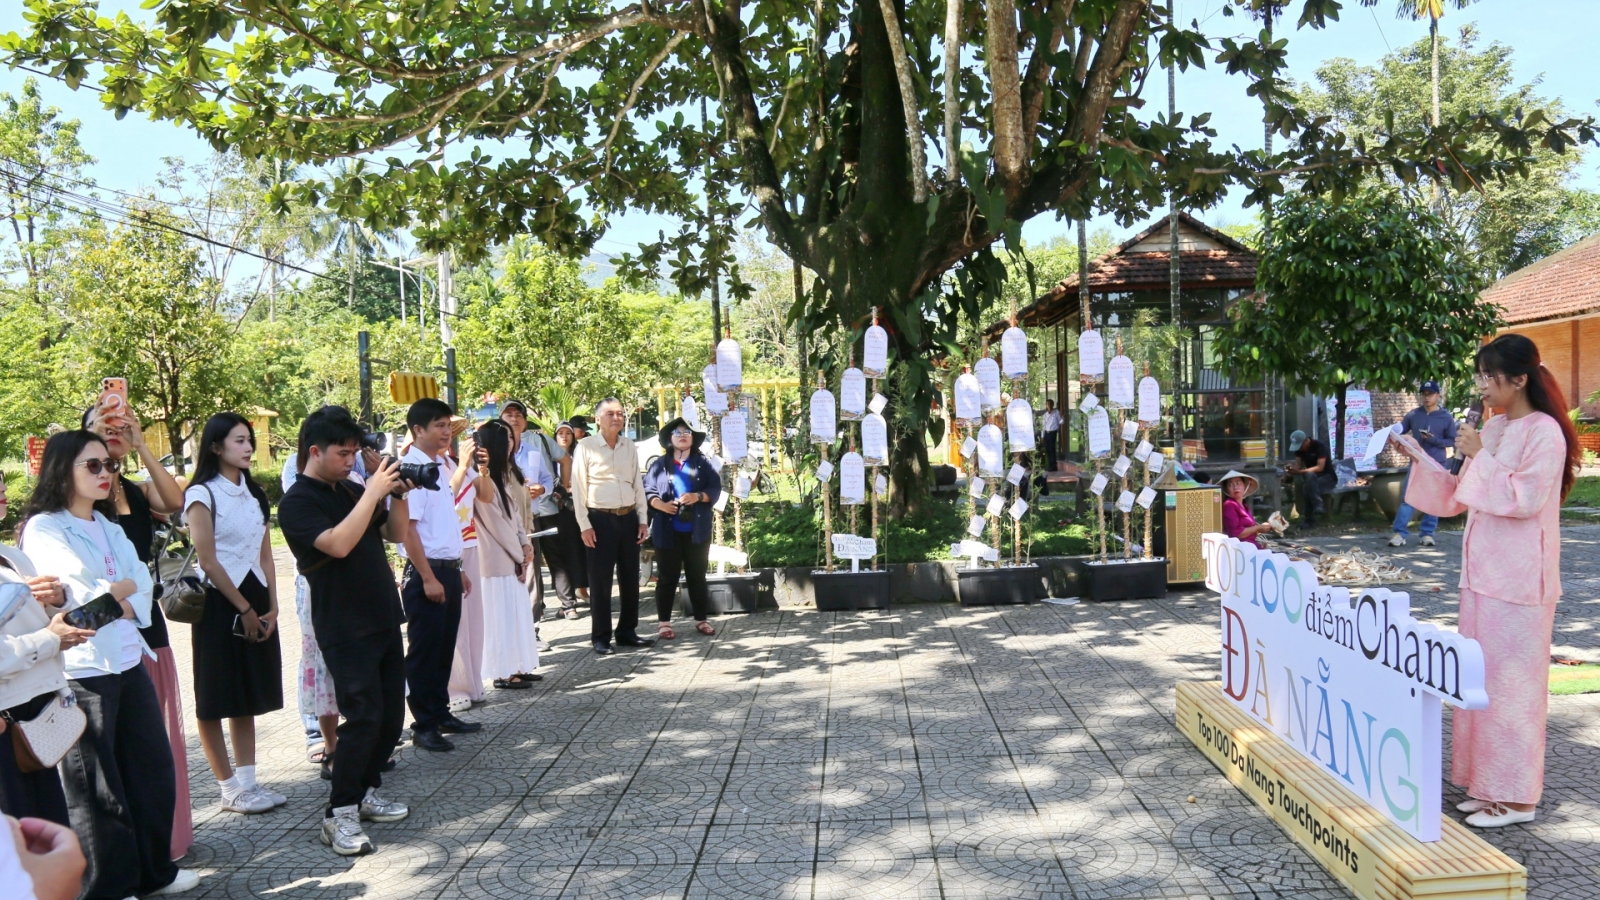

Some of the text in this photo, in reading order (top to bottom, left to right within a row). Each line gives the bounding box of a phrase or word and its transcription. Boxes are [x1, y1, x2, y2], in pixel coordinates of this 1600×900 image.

[1203, 538, 1464, 701] TOP 100 điểm Chạm
[1197, 712, 1359, 874] Top 100 Da Nang Touchpoints
[1222, 605, 1419, 832] ĐÀ NẴNG
